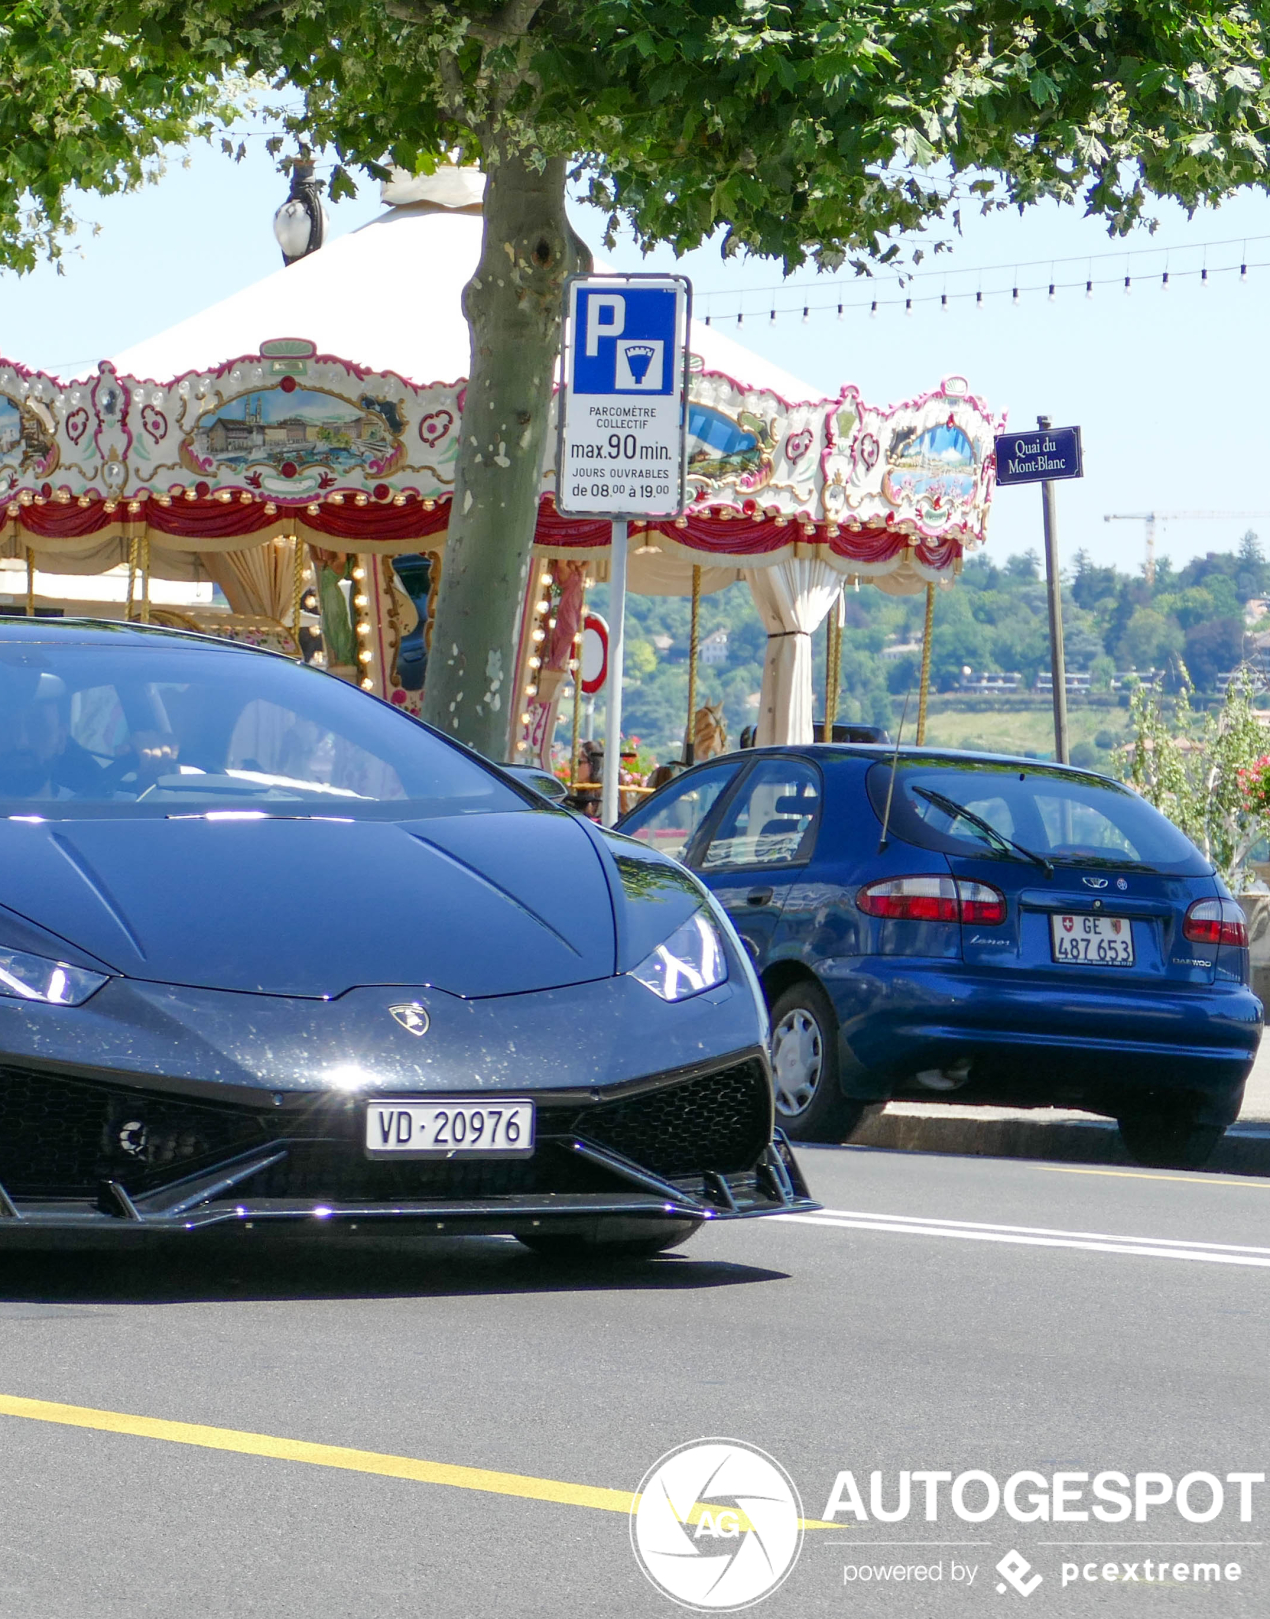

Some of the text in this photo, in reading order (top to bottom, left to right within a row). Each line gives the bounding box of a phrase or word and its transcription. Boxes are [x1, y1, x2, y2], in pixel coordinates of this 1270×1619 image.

[586, 293, 626, 357] P
[589, 405, 657, 418] PARCOMÈTRE
[596, 418, 649, 429] COLLECTIF
[640, 441, 672, 460] min.
[1015, 437, 1056, 457] Quai du
[572, 467, 670, 479] JOURS OUVRABLES
[1008, 455, 1066, 475] Mont-Blanc
[572, 483, 588, 497] de
[628, 485, 636, 498] à
[1083, 917, 1102, 935] GE
[1058, 937, 1131, 962] 487 653
[1172, 958, 1212, 968] DAEWOO
